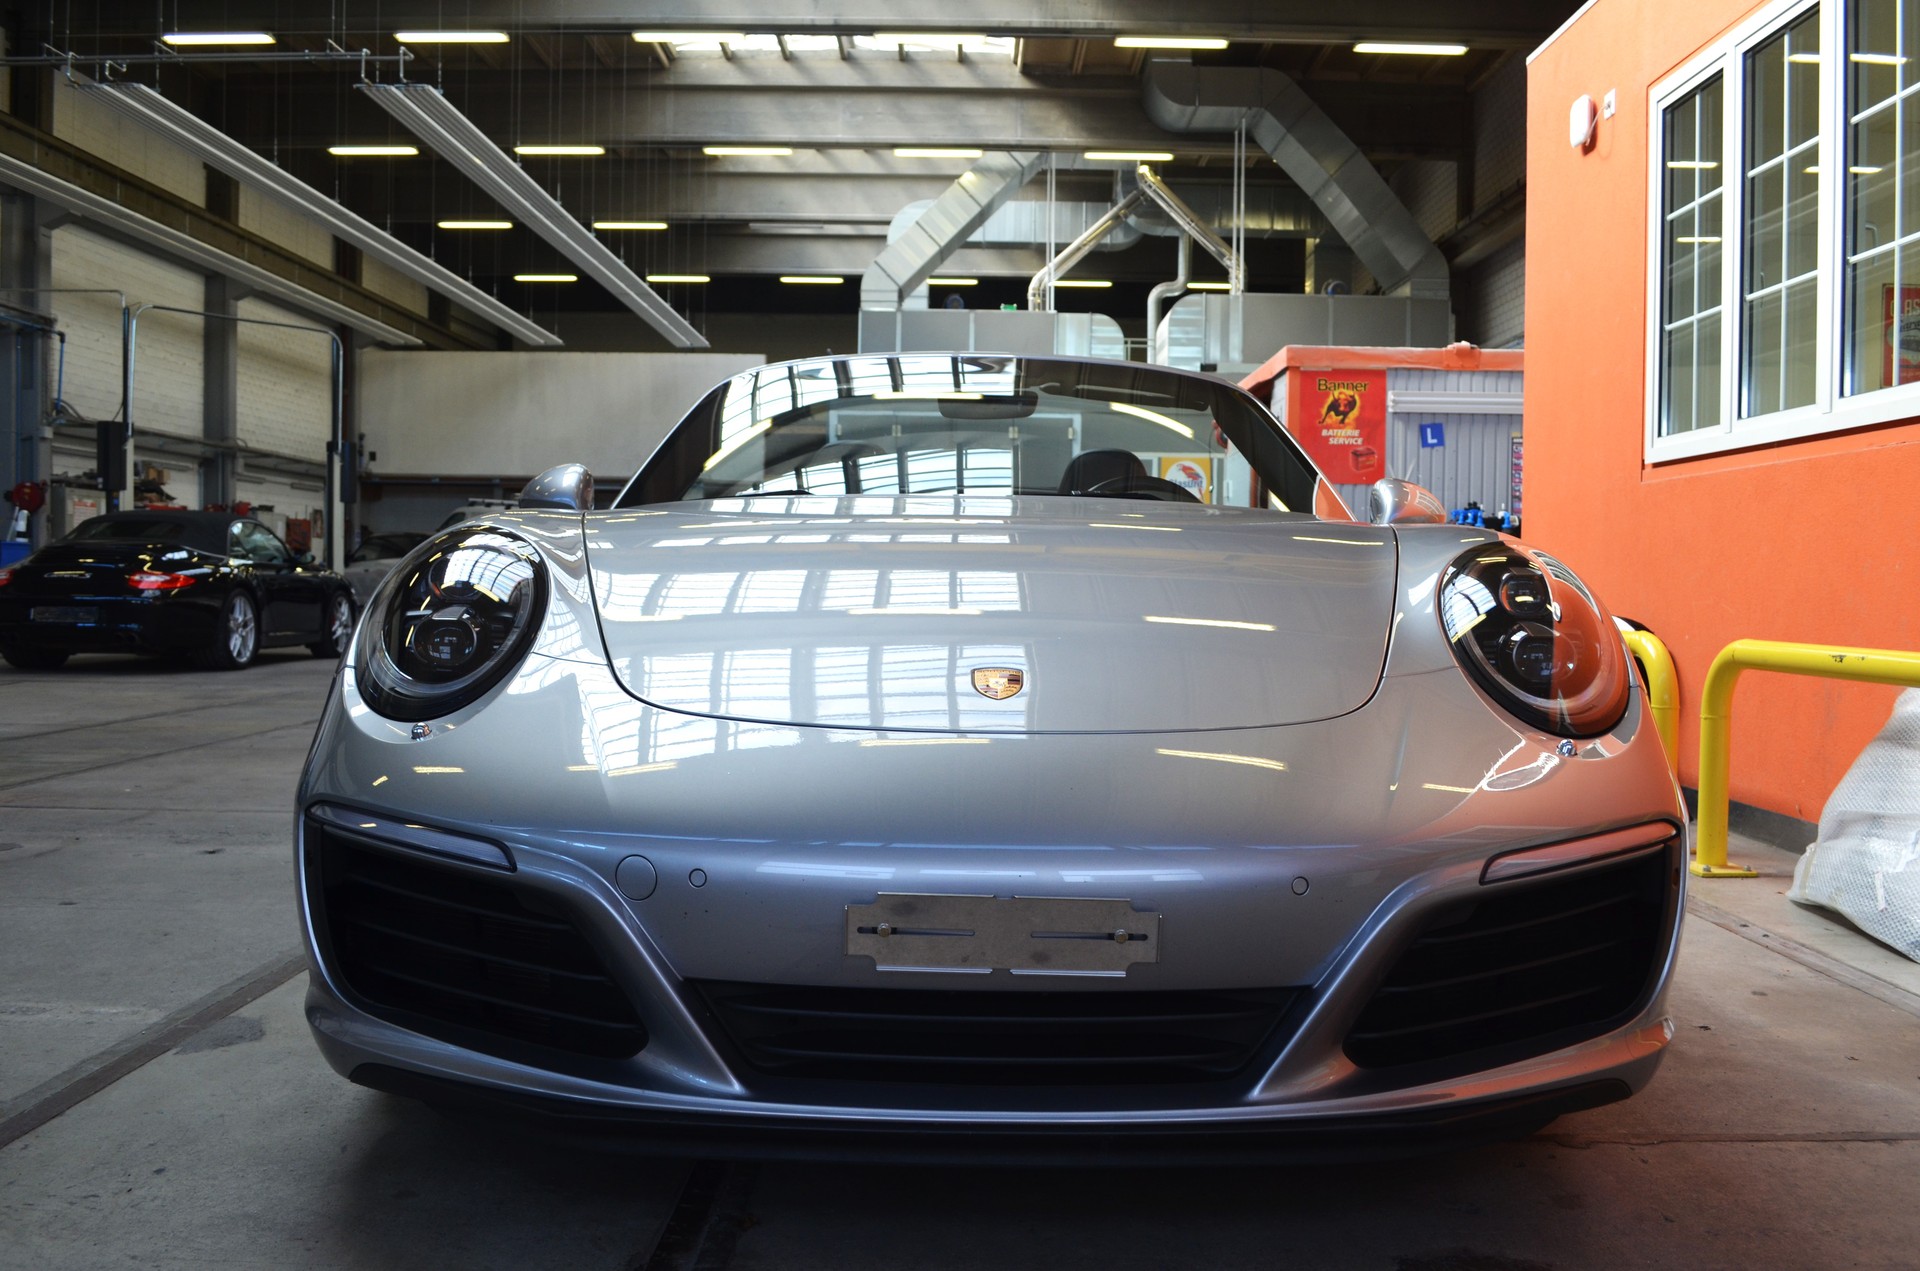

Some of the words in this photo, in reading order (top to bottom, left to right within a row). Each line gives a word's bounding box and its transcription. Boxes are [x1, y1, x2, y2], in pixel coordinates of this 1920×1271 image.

[1317, 378, 1369, 392] Banner
[1321, 429, 1361, 437] BATTERIE
[1426, 427, 1438, 444] L
[1328, 437, 1364, 445] SERVICE
